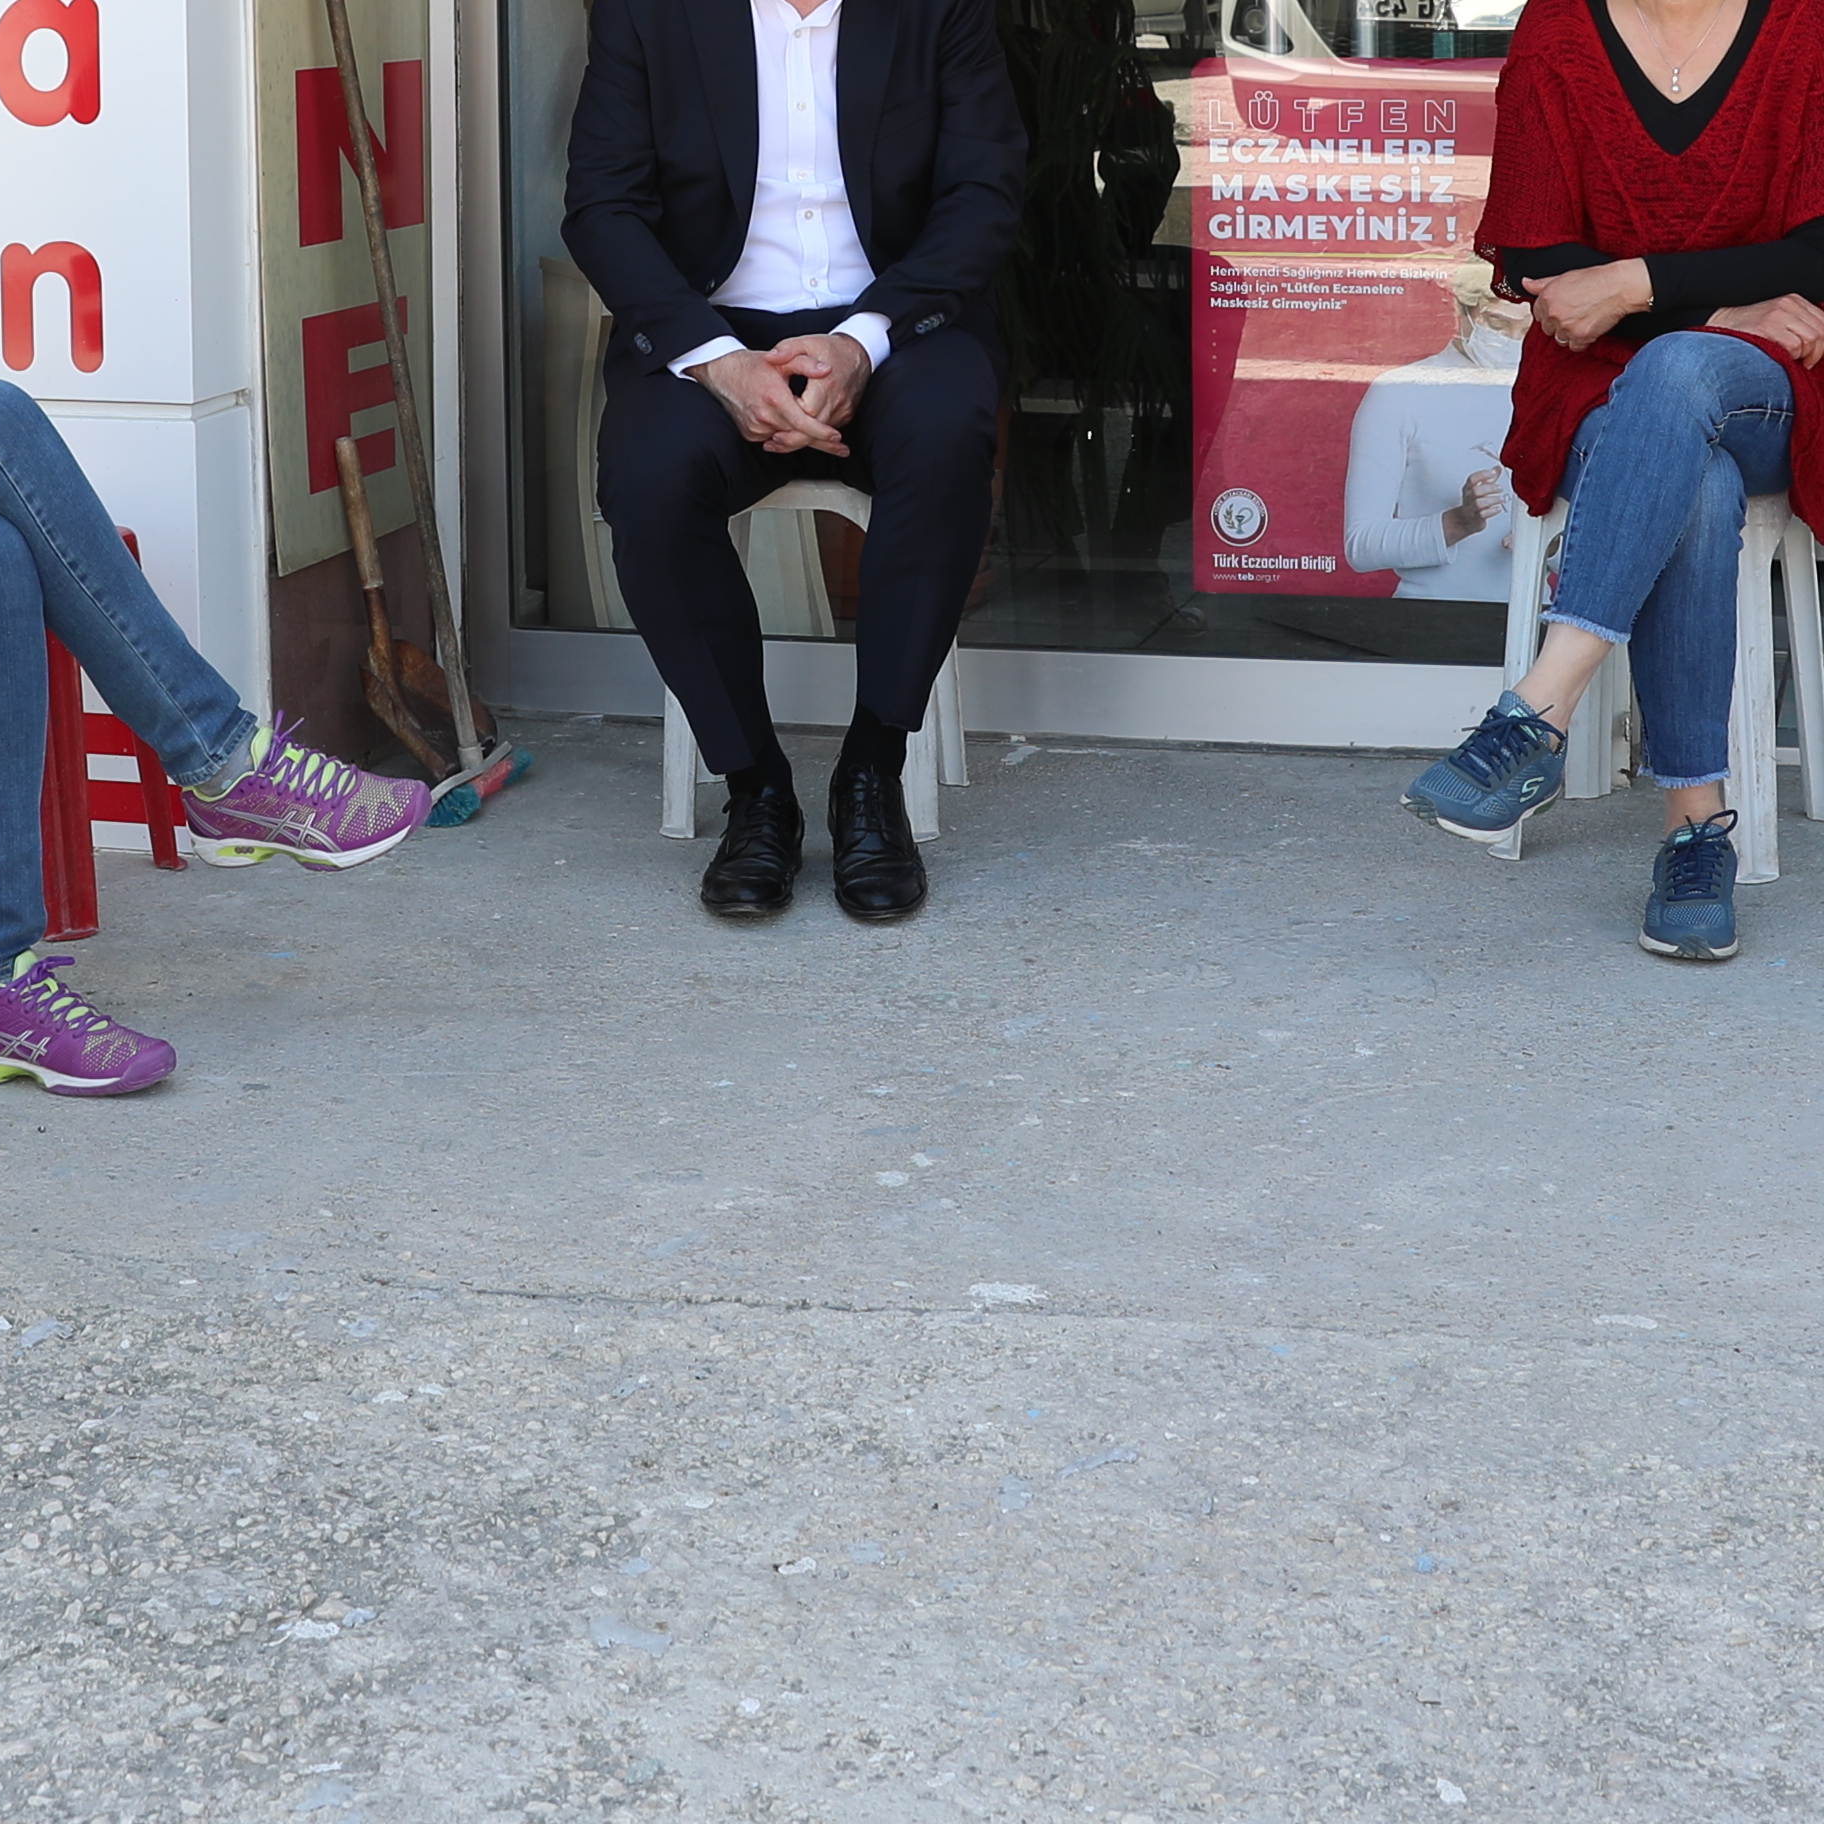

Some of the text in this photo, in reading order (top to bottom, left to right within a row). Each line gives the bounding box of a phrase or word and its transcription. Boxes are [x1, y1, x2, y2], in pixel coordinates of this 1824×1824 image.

[1208, 90, 1456, 133] LÜTFEN
[1208, 138, 1456, 165] ECZANELERE
[1211, 165, 1455, 203] MASKESİZ
[1208, 205, 1433, 241] GİRMEYİNİZ
[1210, 266, 1448, 280] Hem Kendi Sağlığınız Hem de Bizlerin
[1210, 281, 1252, 295] Sağlığı
[1255, 280, 1278, 295] İçin
[1332, 283, 1405, 295] Eczanelere
[1210, 297, 1269, 309] Maskesiz
[1212, 553, 1336, 573] Türk Eczacıları Birliği
[1212, 572, 1281, 583] www.teb.org.tr
